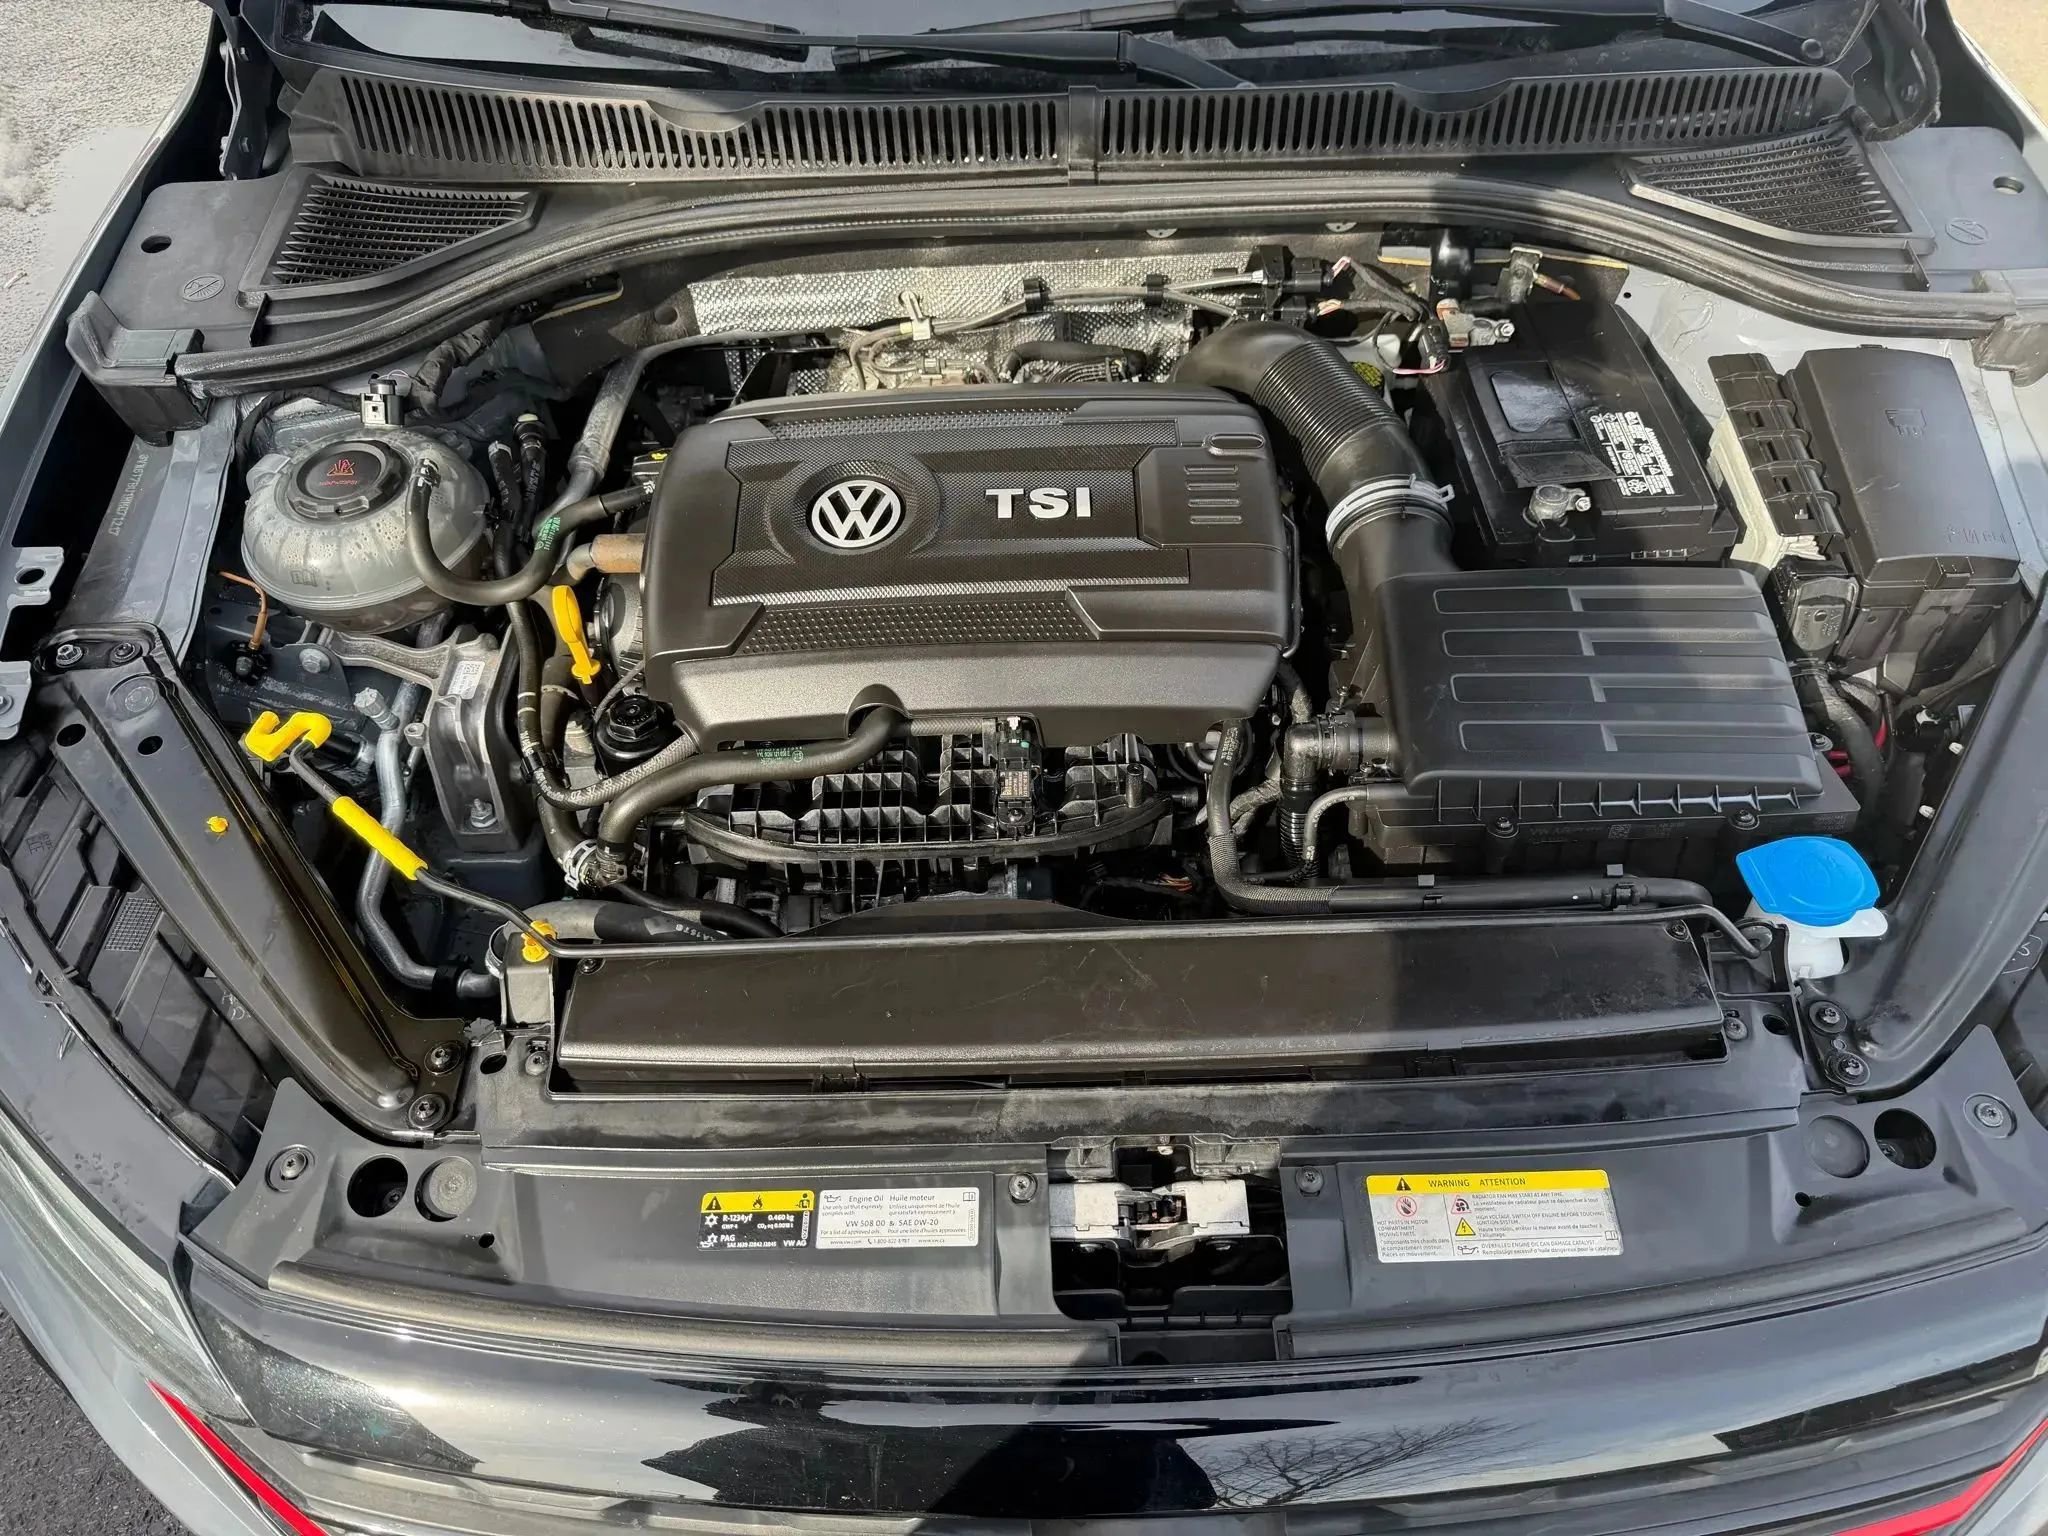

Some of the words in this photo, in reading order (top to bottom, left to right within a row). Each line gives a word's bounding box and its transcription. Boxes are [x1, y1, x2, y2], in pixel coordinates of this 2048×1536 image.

[985, 487, 1091, 519] TSI
[1428, 1179, 1470, 1188] WARNING
[1480, 1177, 1526, 1186] ATTENTION
[849, 1195, 873, 1204] Engine
[873, 1194, 884, 1202] Oil
[889, 1194, 908, 1202] Huile
[722, 1213, 753, 1223] R-1234yf
[786, 1213, 795, 1222] kg
[860, 1219, 874, 1227] 508
[913, 1218, 939, 1226] 0W-20
[720, 1234, 736, 1242] PAG
[783, 1239, 795, 1247] VW
